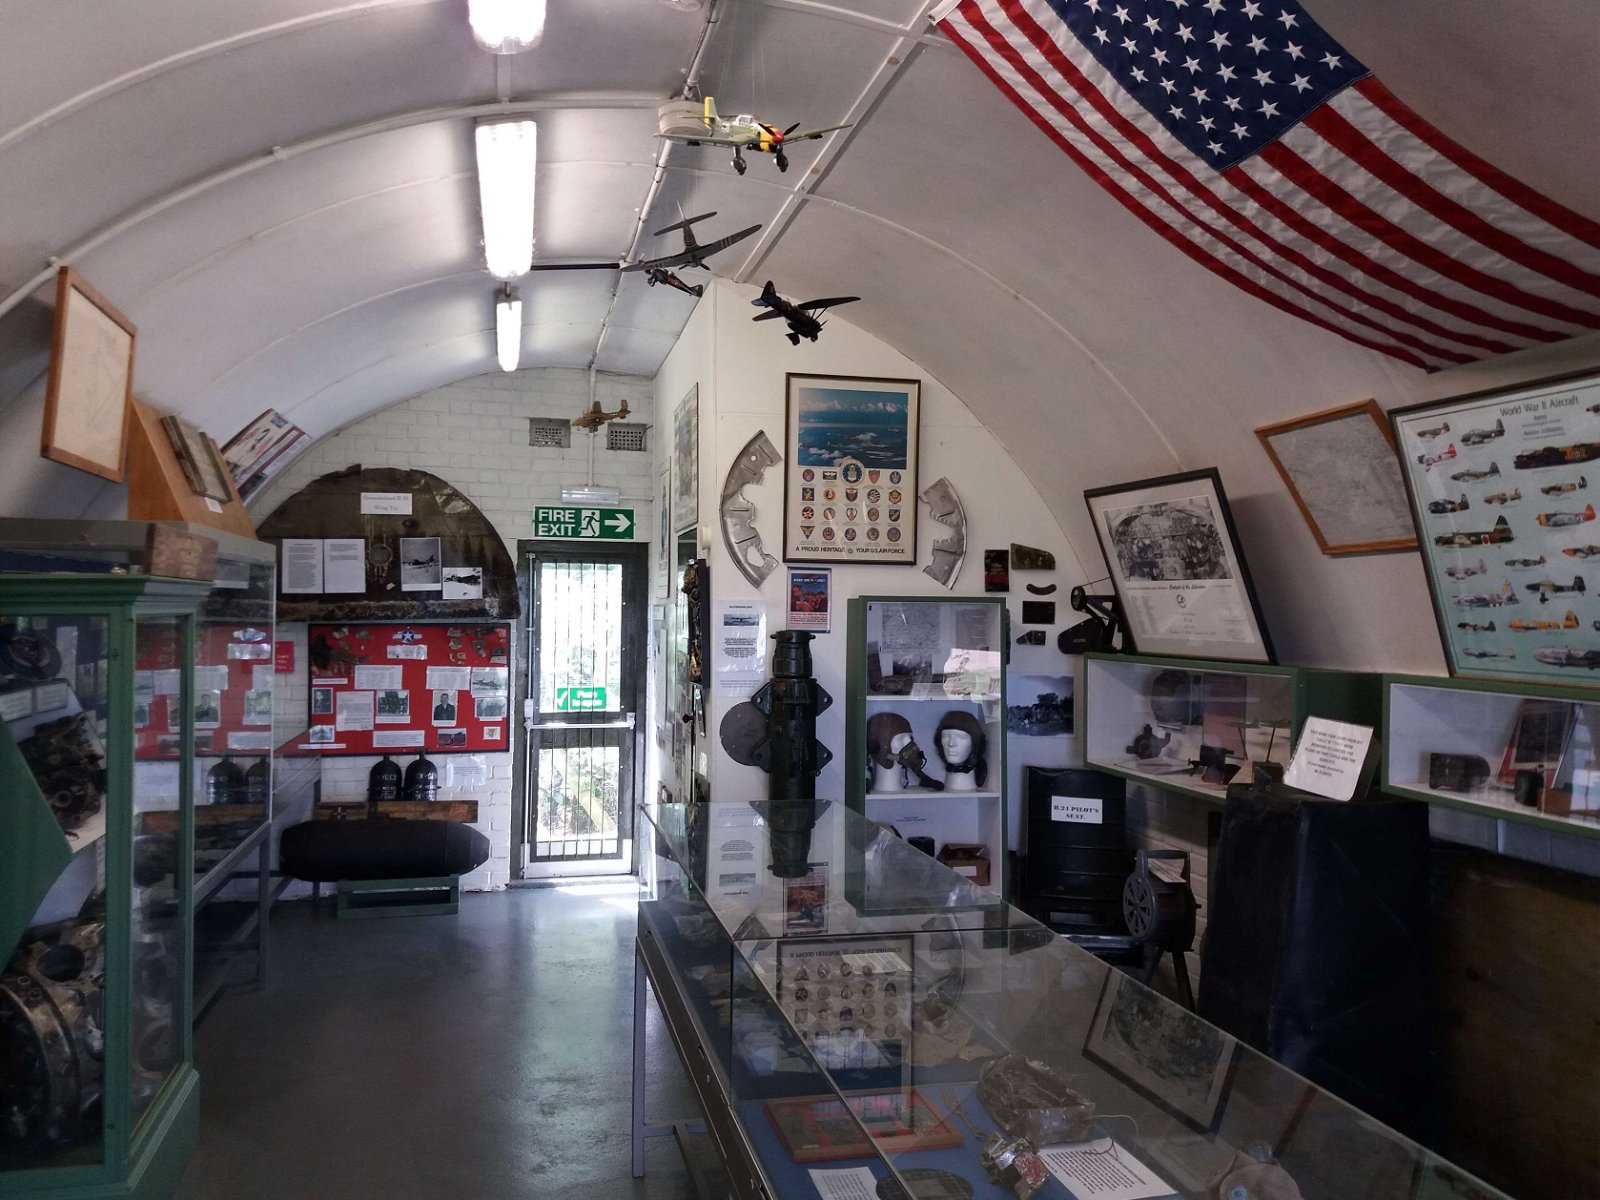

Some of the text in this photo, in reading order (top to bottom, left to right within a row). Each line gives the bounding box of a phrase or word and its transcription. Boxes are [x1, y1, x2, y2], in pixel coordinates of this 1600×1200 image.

[1500, 395, 1579, 416] World War II Aircraft
[538, 509, 576, 522] FIRE
[538, 523, 576, 536] EXIT
